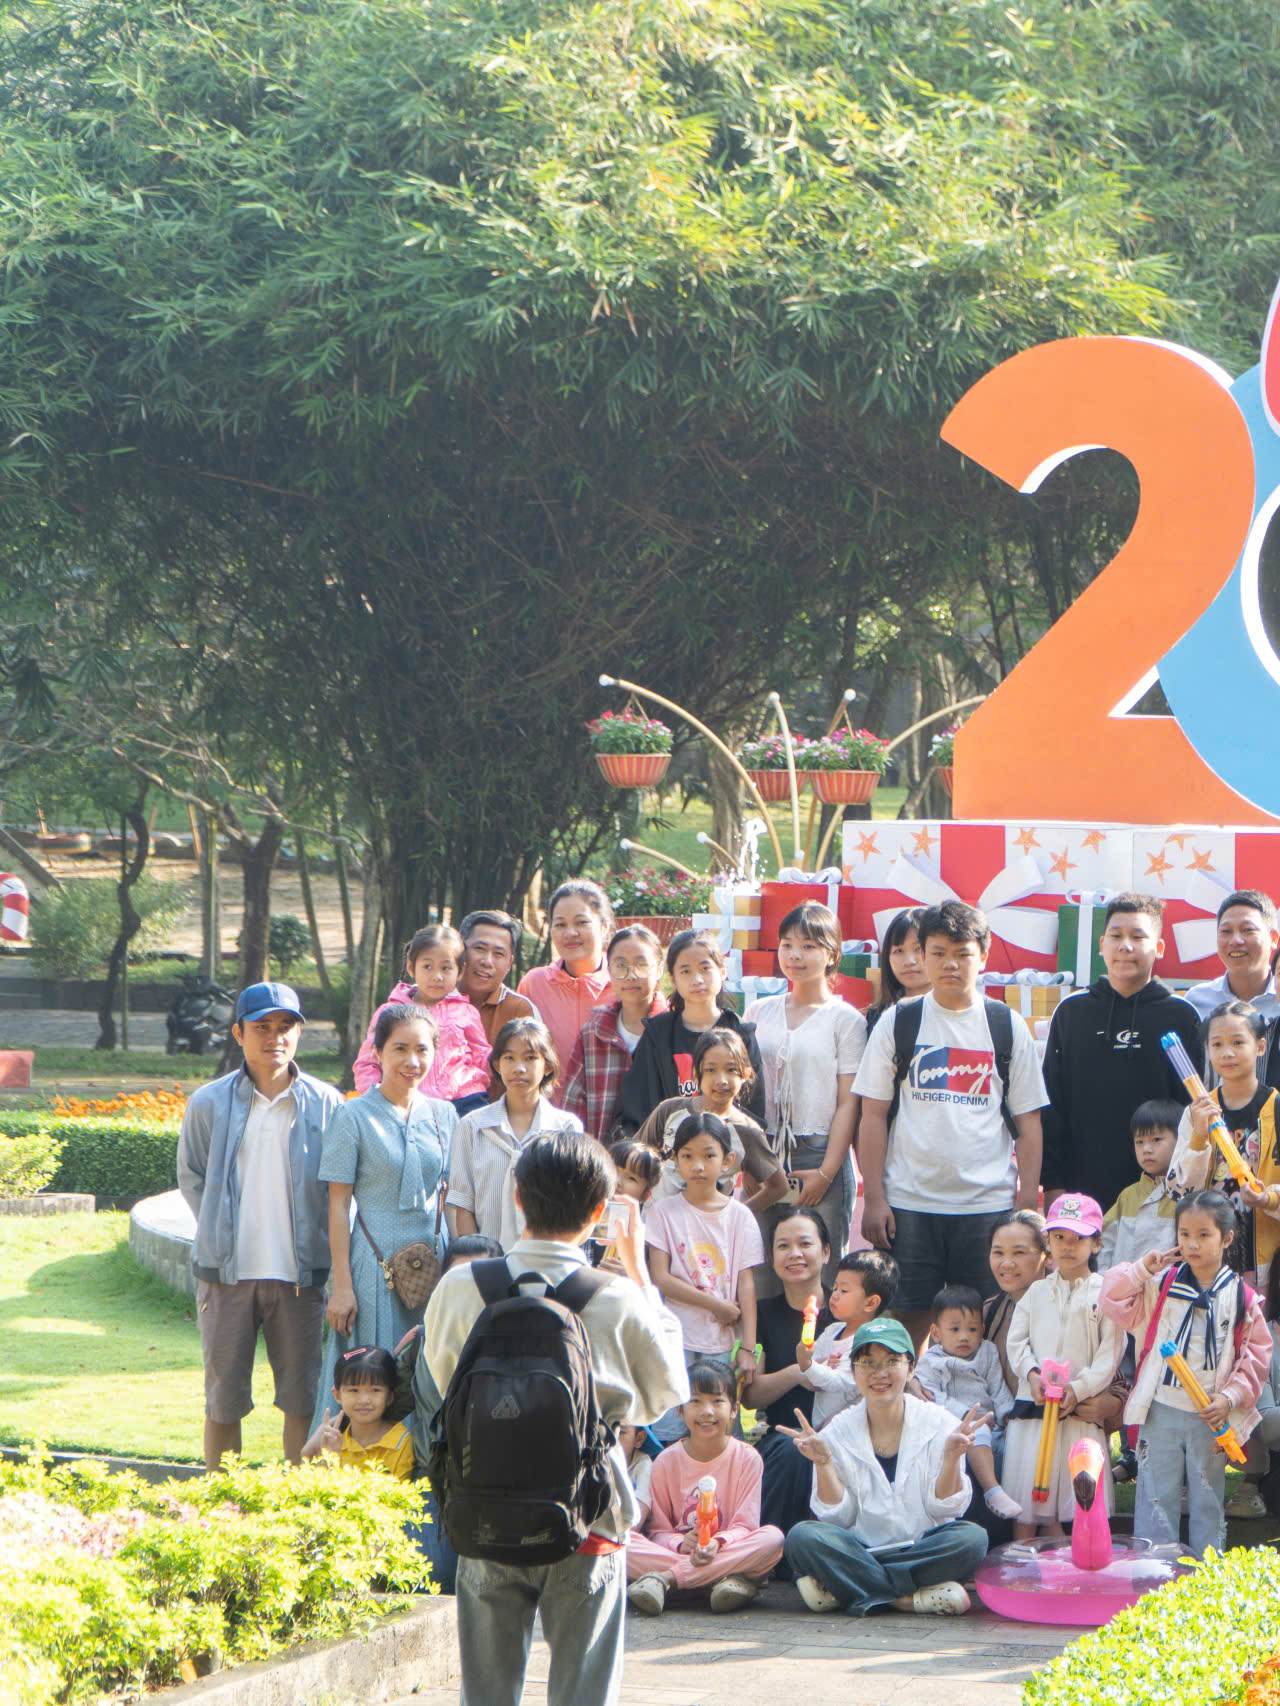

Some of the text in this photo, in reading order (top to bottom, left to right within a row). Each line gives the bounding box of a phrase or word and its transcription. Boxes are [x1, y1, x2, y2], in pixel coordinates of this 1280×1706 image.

[909, 1045, 994, 1095] Tommy
[911, 1090, 989, 1107] HILFIGER DENIM
